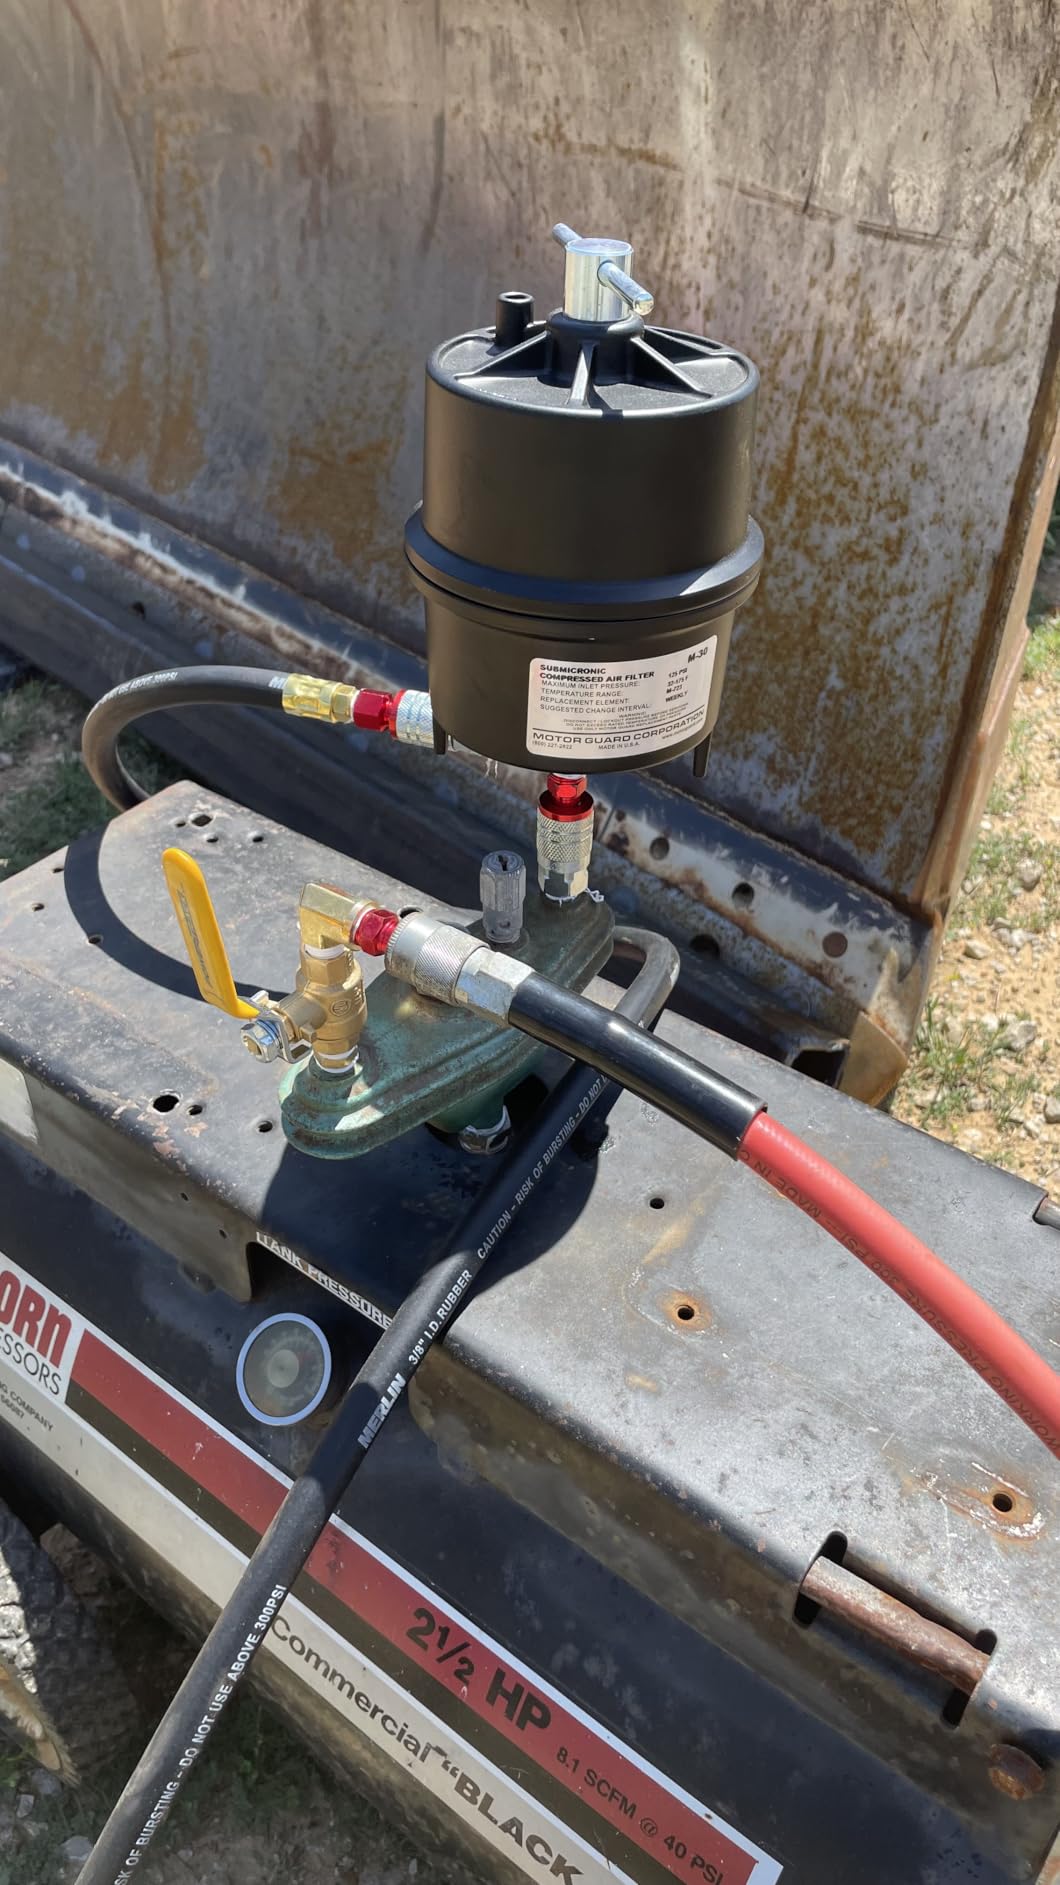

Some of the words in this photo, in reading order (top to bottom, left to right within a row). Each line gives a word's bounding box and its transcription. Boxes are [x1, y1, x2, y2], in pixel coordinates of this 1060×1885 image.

[540, 664, 607, 675] SUBMICRONIC
[687, 646, 708, 664] M-30
[540, 672, 604, 683] COMPRESSED
[625, 671, 655, 681] FILTER
[541, 680, 576, 689] MAXIMUM
[541, 688, 595, 697] TEMPERATURE
[539, 704, 584, 713] SUGGESTED
[586, 706, 616, 714] CHANGE
[540, 695, 594, 705] REPLACEMENT
[665, 690, 689, 702] WEEKLY
[533, 732, 582, 744] MOTOR
[584, 735, 631, 744] GUARD
[633, 708, 705, 740] CORPORATION
[754, 1160, 773, 1179] IN
[775, 1177, 822, 1219] MADE
[357, 1372, 406, 1449] MERLIN
[408, 1338, 425, 1365] 3/8"
[424, 1320, 442, 1340] I.D.
[436, 1269, 472, 1320] RUBBER
[477, 1210, 512, 1259] CAUTION
[514, 1177, 534, 1205] RISK
[532, 1160, 544, 1179] OF
[542, 1116, 576, 1166] BURSTING
[578, 1096, 590, 1114] DO
[587, 1078, 602, 1101] NOT
[841, 1231, 872, 1260] PSI
[905, 1287, 989, 1372] PRESSURE
[0, 1327, 62, 1395] SSORS
[10, 1390, 54, 1432] COMPANY
[991, 1375, 1060, 1452] WORKING
[271, 1615, 433, 1763] Commercial
[485, 1667, 552, 1732] HP
[125, 1849, 142, 1866] OF
[135, 1781, 180, 1846] BURSTING
[178, 1747, 199, 1769] DO
[191, 1714, 217, 1744] NOT
[209, 1684, 233, 1713] USE
[226, 1633, 260, 1682] ABOVE
[254, 1583, 287, 1632] 300PSI
[556, 1746, 580, 1774] 8.1
[584, 1768, 638, 1820] SCFM
[640, 1817, 658, 1838] @
[663, 1834, 687, 1860] 40
[690, 1853, 724, 1885] PSI
